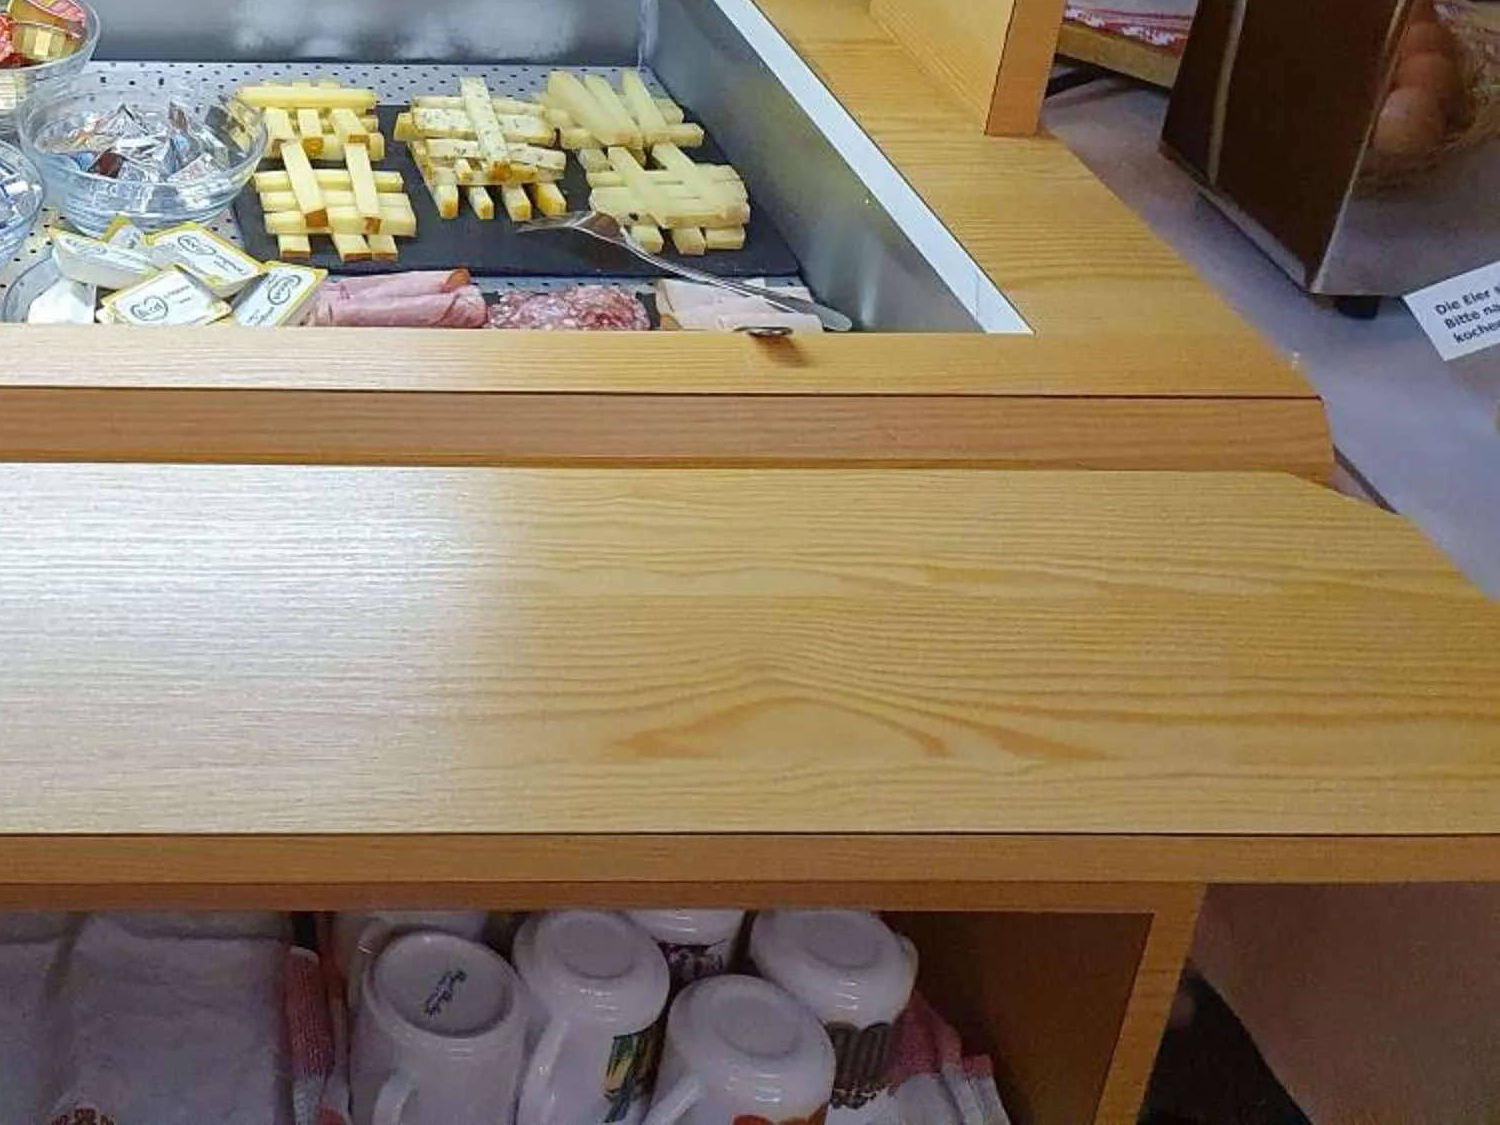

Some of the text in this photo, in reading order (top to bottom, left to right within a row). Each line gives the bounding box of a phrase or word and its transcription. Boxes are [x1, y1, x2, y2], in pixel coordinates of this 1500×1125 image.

[1435, 290, 1489, 315] Die Eier
[1444, 311, 1481, 329] Bitte
